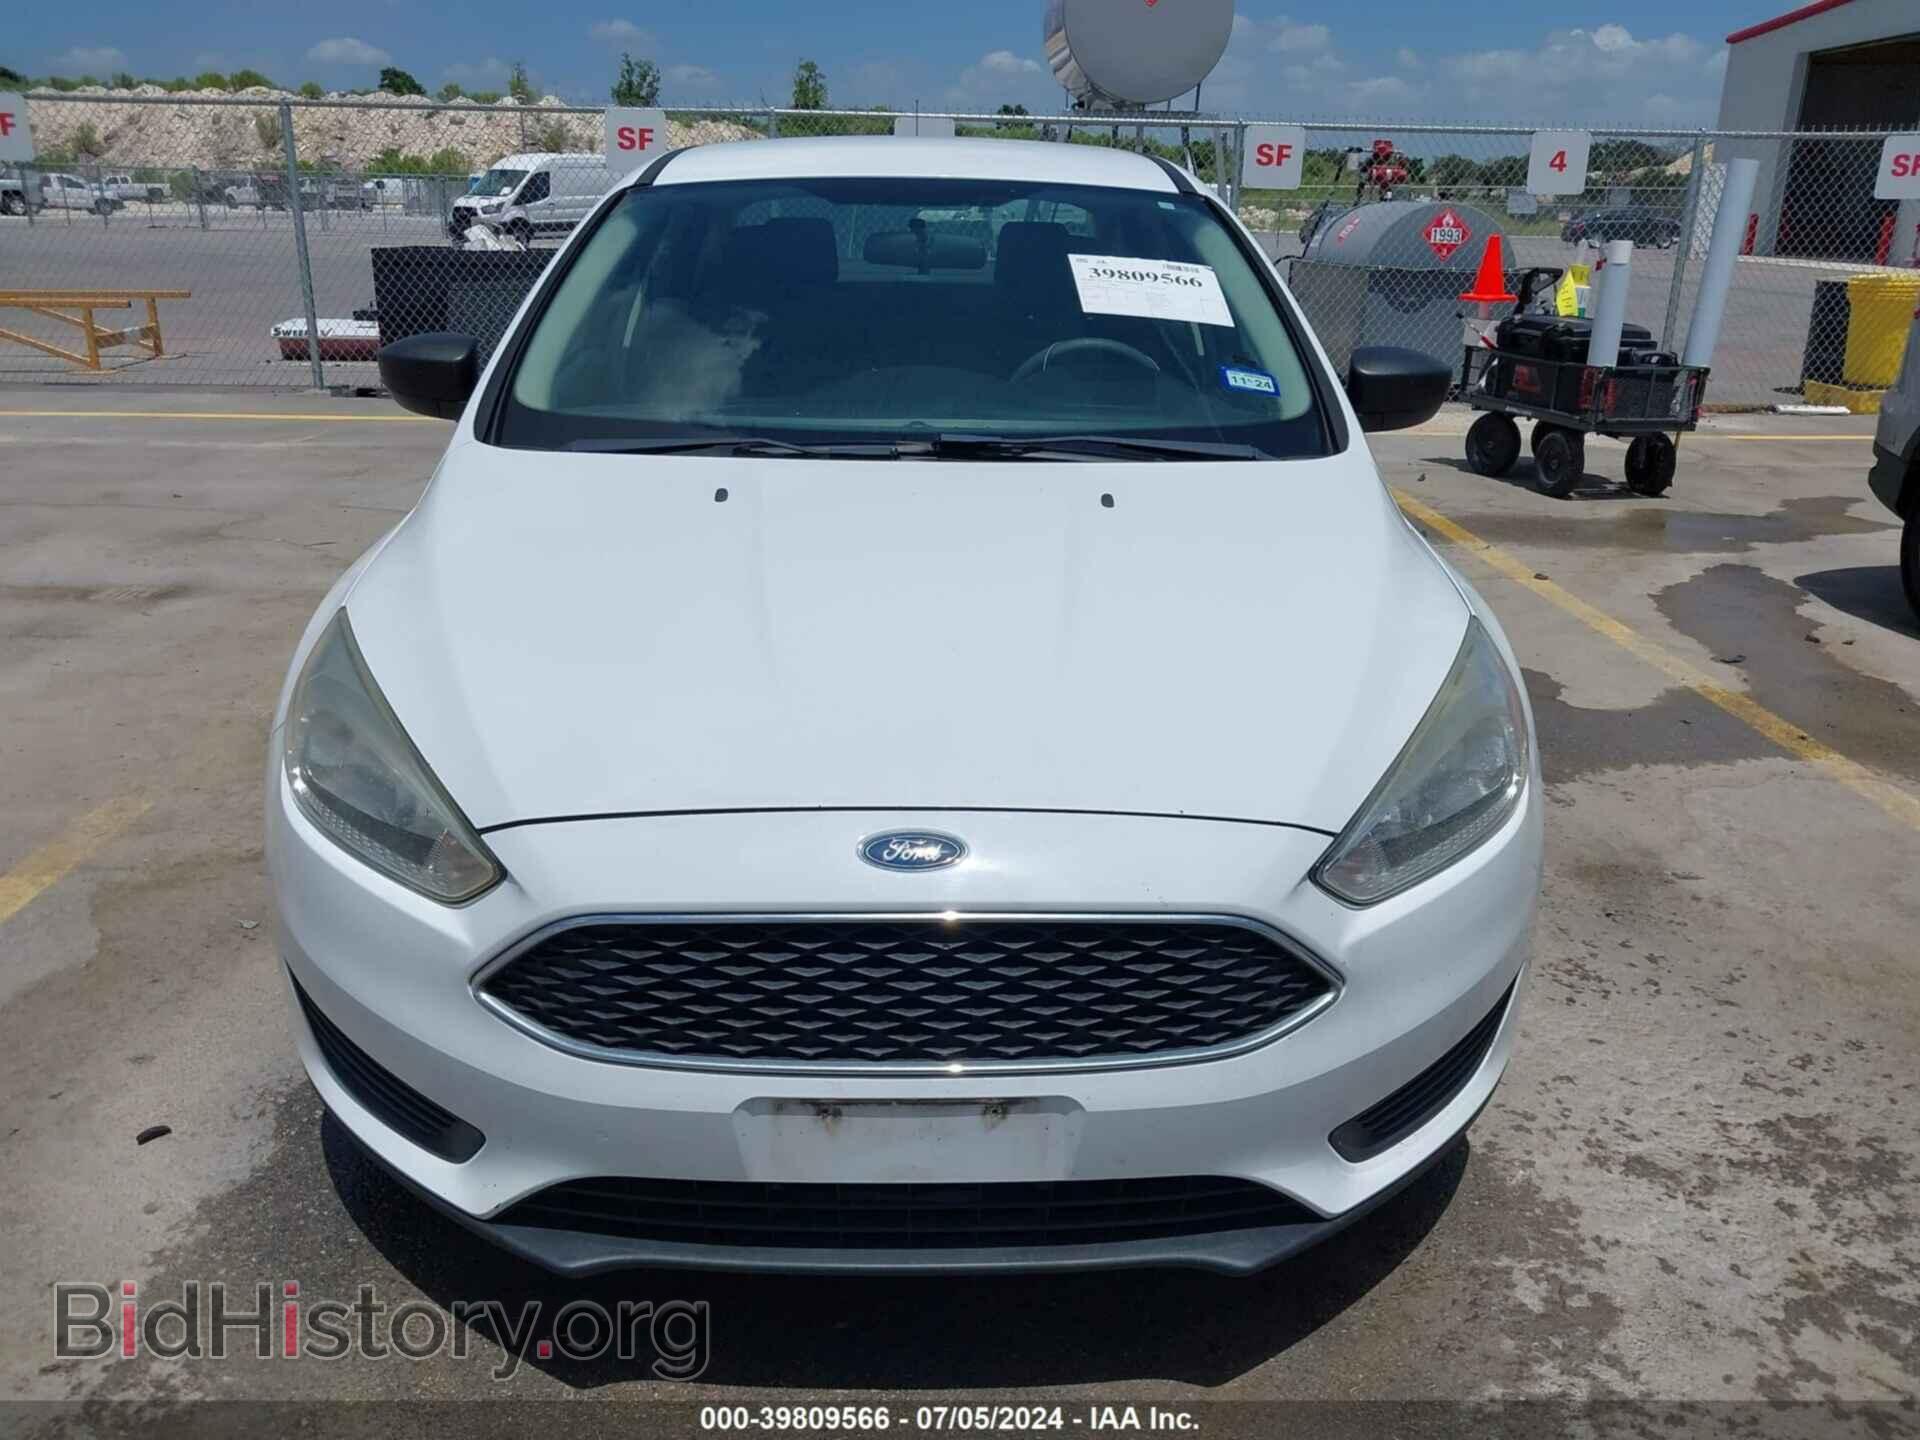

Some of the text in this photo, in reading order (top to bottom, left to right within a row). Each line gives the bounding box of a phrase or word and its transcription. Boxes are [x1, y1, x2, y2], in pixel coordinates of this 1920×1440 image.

[617, 126, 654, 150] SF
[1256, 143, 1292, 167] SF
[1549, 150, 1567, 172] 4
[1433, 228, 1461, 242] 1993
[1088, 267, 1203, 287] 39809566
[882, 837, 945, 861] Ford
